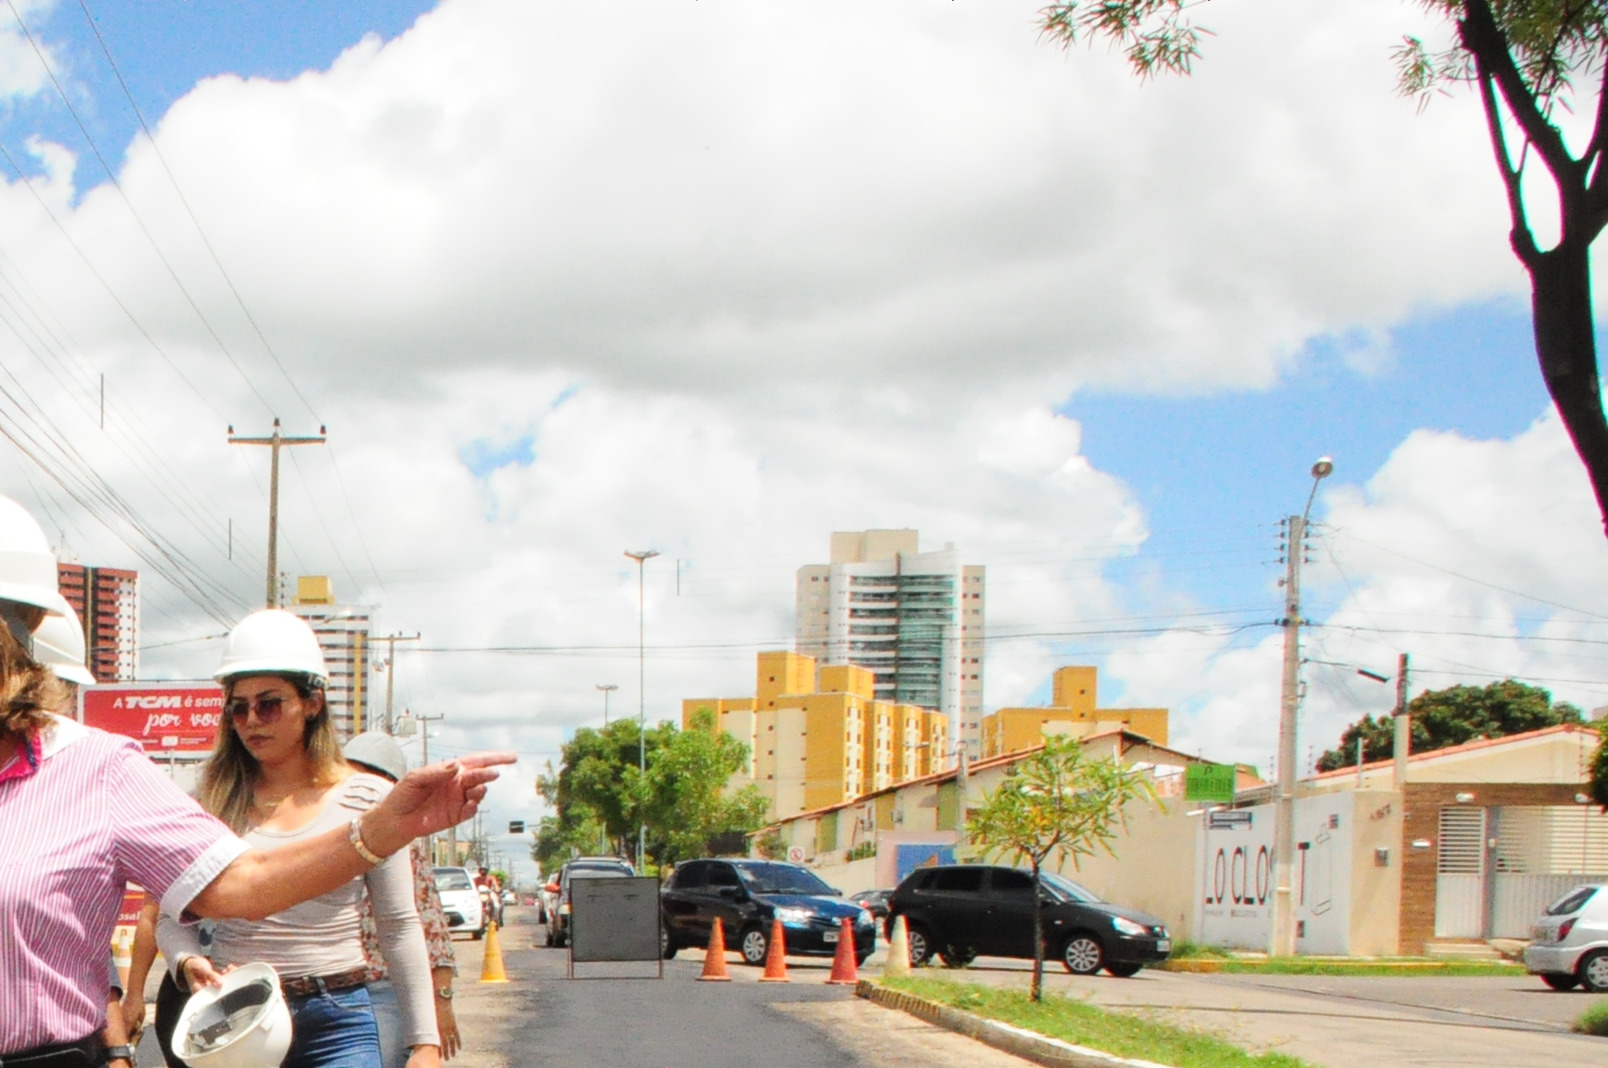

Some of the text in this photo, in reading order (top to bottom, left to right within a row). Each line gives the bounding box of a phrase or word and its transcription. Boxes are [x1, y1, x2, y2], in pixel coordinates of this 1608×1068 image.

[113, 697, 123, 709] A
[124, 695, 182, 710] TCM
[184, 695, 193, 708] é
[142, 713, 181, 736] por
[1230, 841, 1311, 906] CLOT
